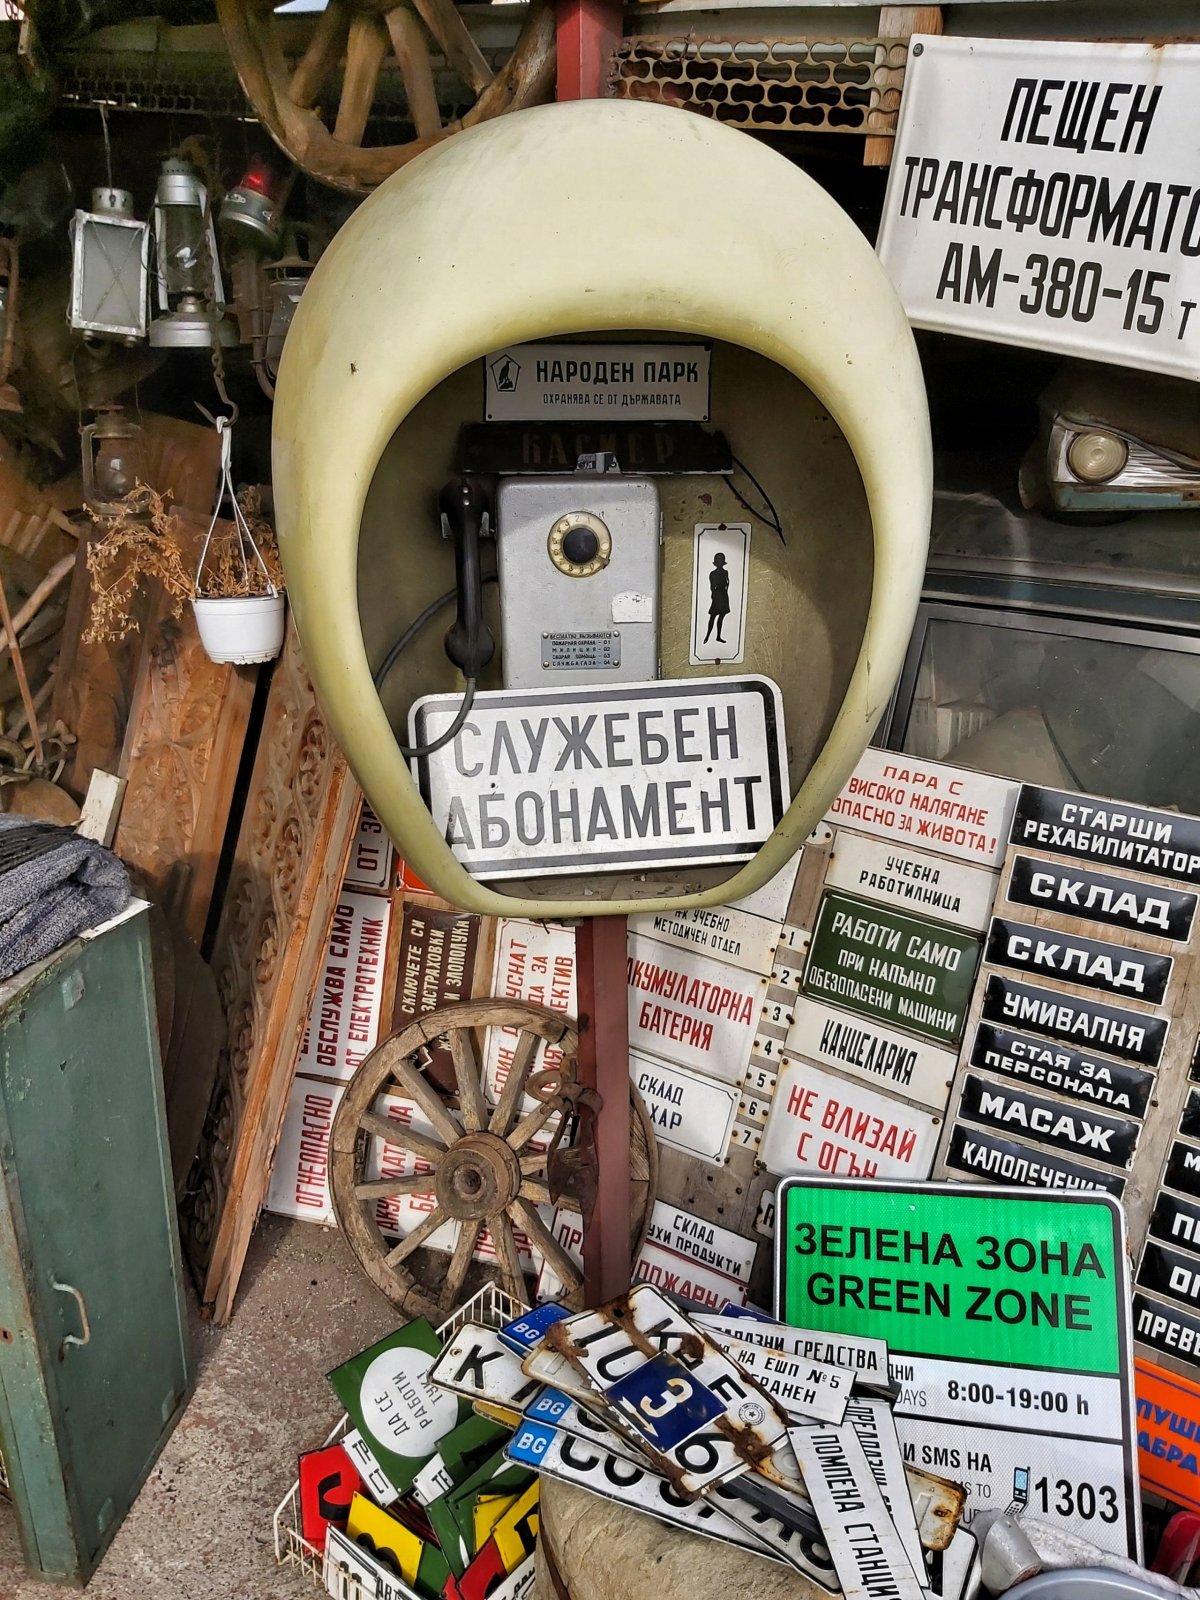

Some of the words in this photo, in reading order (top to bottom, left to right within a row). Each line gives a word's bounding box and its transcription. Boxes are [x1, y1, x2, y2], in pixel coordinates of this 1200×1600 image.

[1000, 78, 1163, 154] ПЕЩЕН
[936, 242, 1170, 335] АМ-380-15
[536, 360, 634, 385] НАРОДЕН
[644, 361, 698, 383] ПАРК
[543, 393, 590, 405] ОХРАНЯВА
[594, 393, 604, 405] СЕ
[608, 393, 617, 405] ОТ
[621, 393, 681, 406] ДЪРЖАВАТА
[453, 705, 738, 777] СЛУЖЕБЕН
[848, 778, 903, 805] ВИСОКО
[909, 792, 988, 827] НАЛЯГАНЕ
[882, 765, 938, 789] ПАРА
[948, 781, 965, 796] С
[446, 775, 762, 850] АБОНАМЕНТ
[831, 797, 895, 828] ОПАСНО
[899, 813, 912, 832] ЗА
[916, 818, 998, 854] ЖИВОТА!
[1061, 803, 1173, 844] СТАРШИ
[357, 843, 378, 871] ОТ
[1024, 819, 1200, 874] РЕХАБИЛИТАТОР
[859, 870, 961, 913] РАБОТИЛНИЦА
[884, 856, 941, 884] УЧЕБНА
[692, 909, 730, 932] УЧЕБНО
[1030, 872, 1171, 930] СКЛАД
[329, 904, 355, 957] САМО
[411, 919, 426, 937] СИ
[653, 916, 709, 945] МЕТОДИЧЕН
[710, 935, 742, 956] ОТДЕЛ
[788, 931, 794, 945] 1
[831, 911, 902, 952] РАБОТИ
[906, 935, 961, 972] САМО
[348, 916, 384, 1043] ЕЛЕКТРОТЕХНИК
[401, 945, 422, 1014] СКЛЮЧЕТЕ
[420, 929, 445, 1012] ЗАСТРАХОВКИ
[531, 956, 549, 974] ЗА
[780, 970, 790, 984] 2
[837, 949, 863, 972] ПРИ
[868, 957, 936, 995] НАПЪЛНО
[1007, 934, 1145, 993] СКЛАД
[528, 985, 545, 1007] ДА
[627, 957, 754, 1025] АКУМУЛАТОРНА
[808, 965, 893, 1011] ОБЕЗОПАСЕНИ
[897, 996, 958, 1033] МАШИНИ
[316, 967, 347, 1067] ОБСЛУЖВА
[638, 1001, 714, 1051] БАТЕРИЯ
[772, 1007, 781, 1021] 3
[1003, 992, 1145, 1052] УМИВАЛНЯ
[764, 1041, 773, 1055] 4
[819, 1019, 918, 1085] КАНЦЕЛАРИЯ
[1010, 1041, 1071, 1070] СТАЯ
[1079, 1061, 1112, 1085] ЗА
[638, 1073, 684, 1106] СКЛАД
[757, 1073, 766, 1087] 5
[985, 1051, 1130, 1110] ПЕРСОНАЛА
[642, 1101, 682, 1130] ХАР
[748, 1101, 757, 1115] 6
[787, 1084, 818, 1122] НЕ
[821, 1098, 919, 1163] ВЛИЗАЙ
[979, 1092, 1116, 1153] МАСАЖ
[295, 1093, 333, 1208] ОГНЕОПАСНО
[742, 1129, 751, 1144] 7
[797, 1132, 813, 1161] С
[818, 1141, 879, 1178] ОГЪН
[647, 1225, 671, 1244] УХИ
[675, 1235, 742, 1277] ПРОДУКТИ
[673, 1214, 715, 1245] СКЛАД
[795, 1222, 963, 1268] ЗЕЛЕНА
[975, 1237, 1106, 1279] ЗОНА
[807, 1272, 951, 1318] GREEN
[965, 1286, 1093, 1332] ZONE
[513, 1323, 540, 1340] BG
[737, 1350, 755, 1366] НА
[764, 1358, 800, 1377] ЕШП
[374, 1391, 394, 1413] СЕ
[392, 1370, 433, 1429] РАБОТИ
[535, 1397, 563, 1416] BG
[640, 1377, 694, 1418] 3
[752, 1374, 816, 1405] РАНЕН
[948, 1380, 1068, 1413] 8:00-19:00
[1077, 1394, 1089, 1415] h
[388, 1412, 411, 1436] ДА
[1136, 1397, 1200, 1444] ПУШ
[517, 1432, 548, 1454] BG
[922, 1445, 961, 1469] SMS
[967, 1451, 992, 1473] НА
[1137, 1431, 1200, 1476] АБРА
[976, 1483, 992, 1498] TO
[1035, 1476, 1119, 1524] 1303
[811, 1434, 866, 1514] ПОМПЕНА
[844, 1522, 902, 1600] СТАНЦИ
